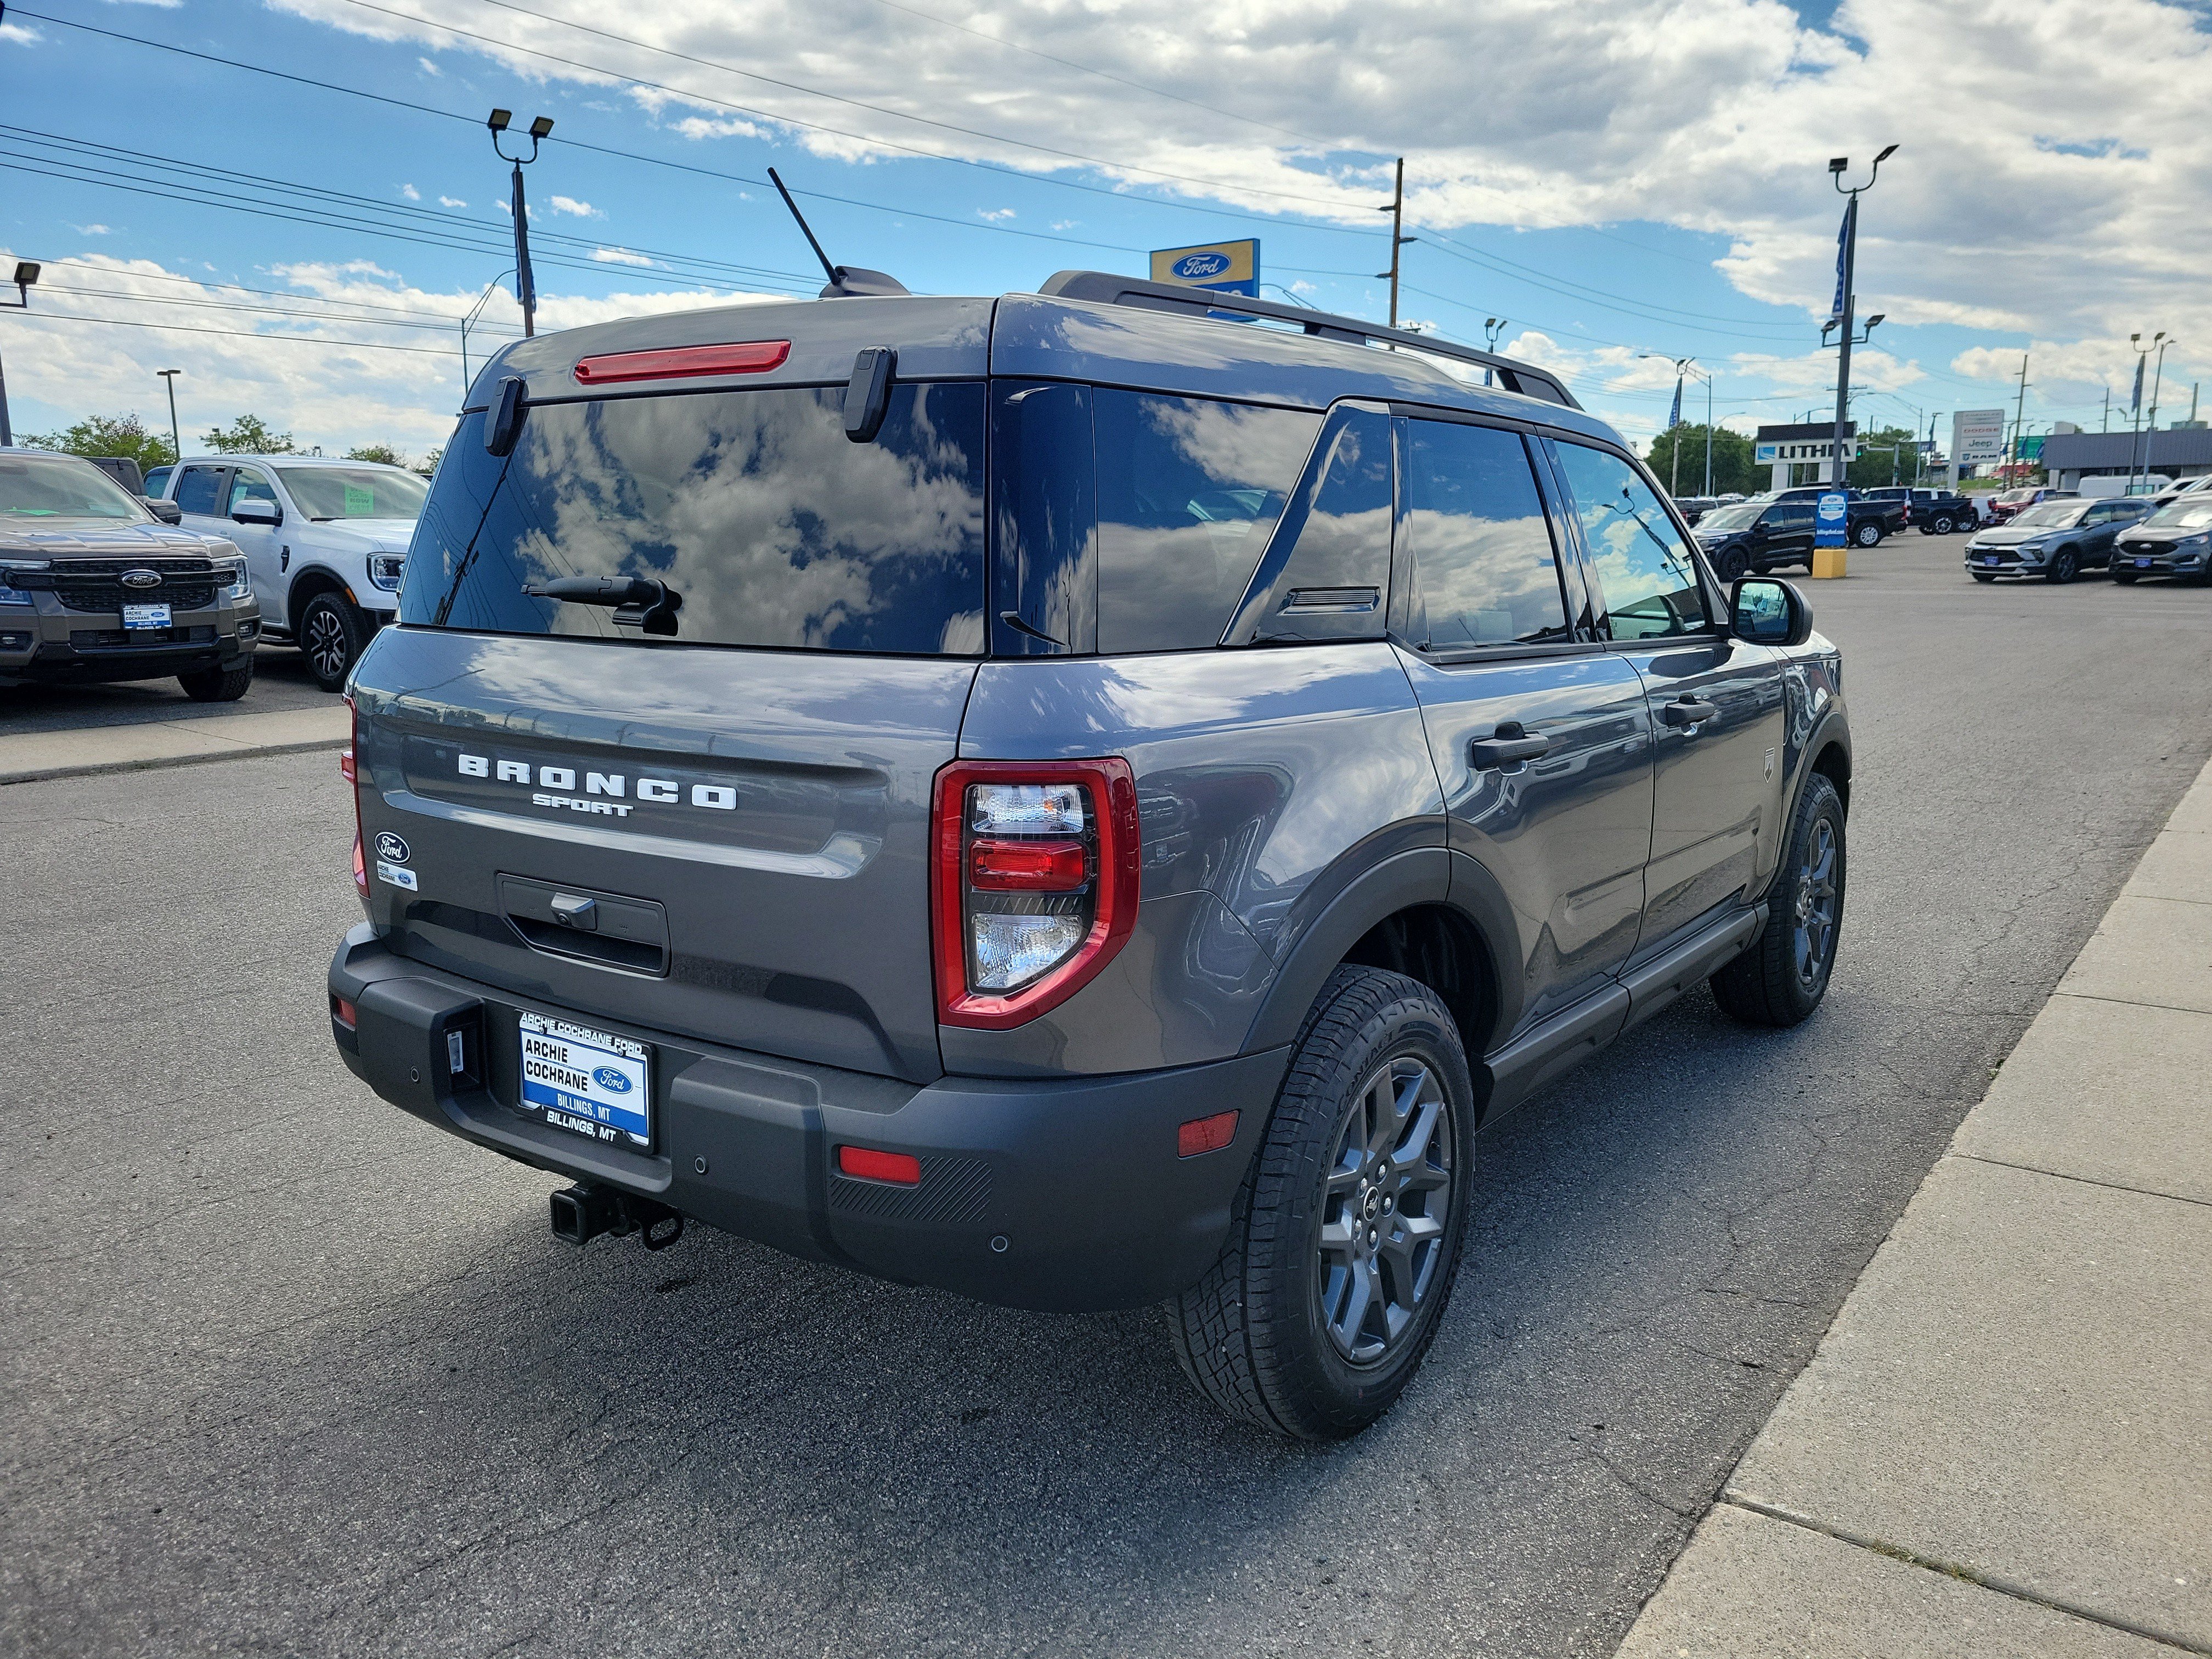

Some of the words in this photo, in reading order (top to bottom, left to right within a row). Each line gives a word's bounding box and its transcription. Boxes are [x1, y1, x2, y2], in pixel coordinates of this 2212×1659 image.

[1183, 256, 1220, 276] Ford
[1968, 439, 1993, 448] Jeep
[132, 575, 154, 584] Ford
[458, 754, 737, 811] BRONCO
[532, 793, 634, 817] SPORT
[381, 836, 403, 859] Ford
[521, 1012, 556, 1030] ARCHIE
[557, 1022, 612, 1046] COCHRANE
[614, 1038, 642, 1054] FORD
[525, 1039, 568, 1064] ARCHIE
[526, 1060, 589, 1092] COCHRANE
[600, 1069, 624, 1090] Ford
[557, 1093, 596, 1119] BILLINGS,
[598, 1105, 611, 1122] MT
[547, 1110, 596, 1138] BILLINGS,
[599, 1126, 617, 1142] MT
